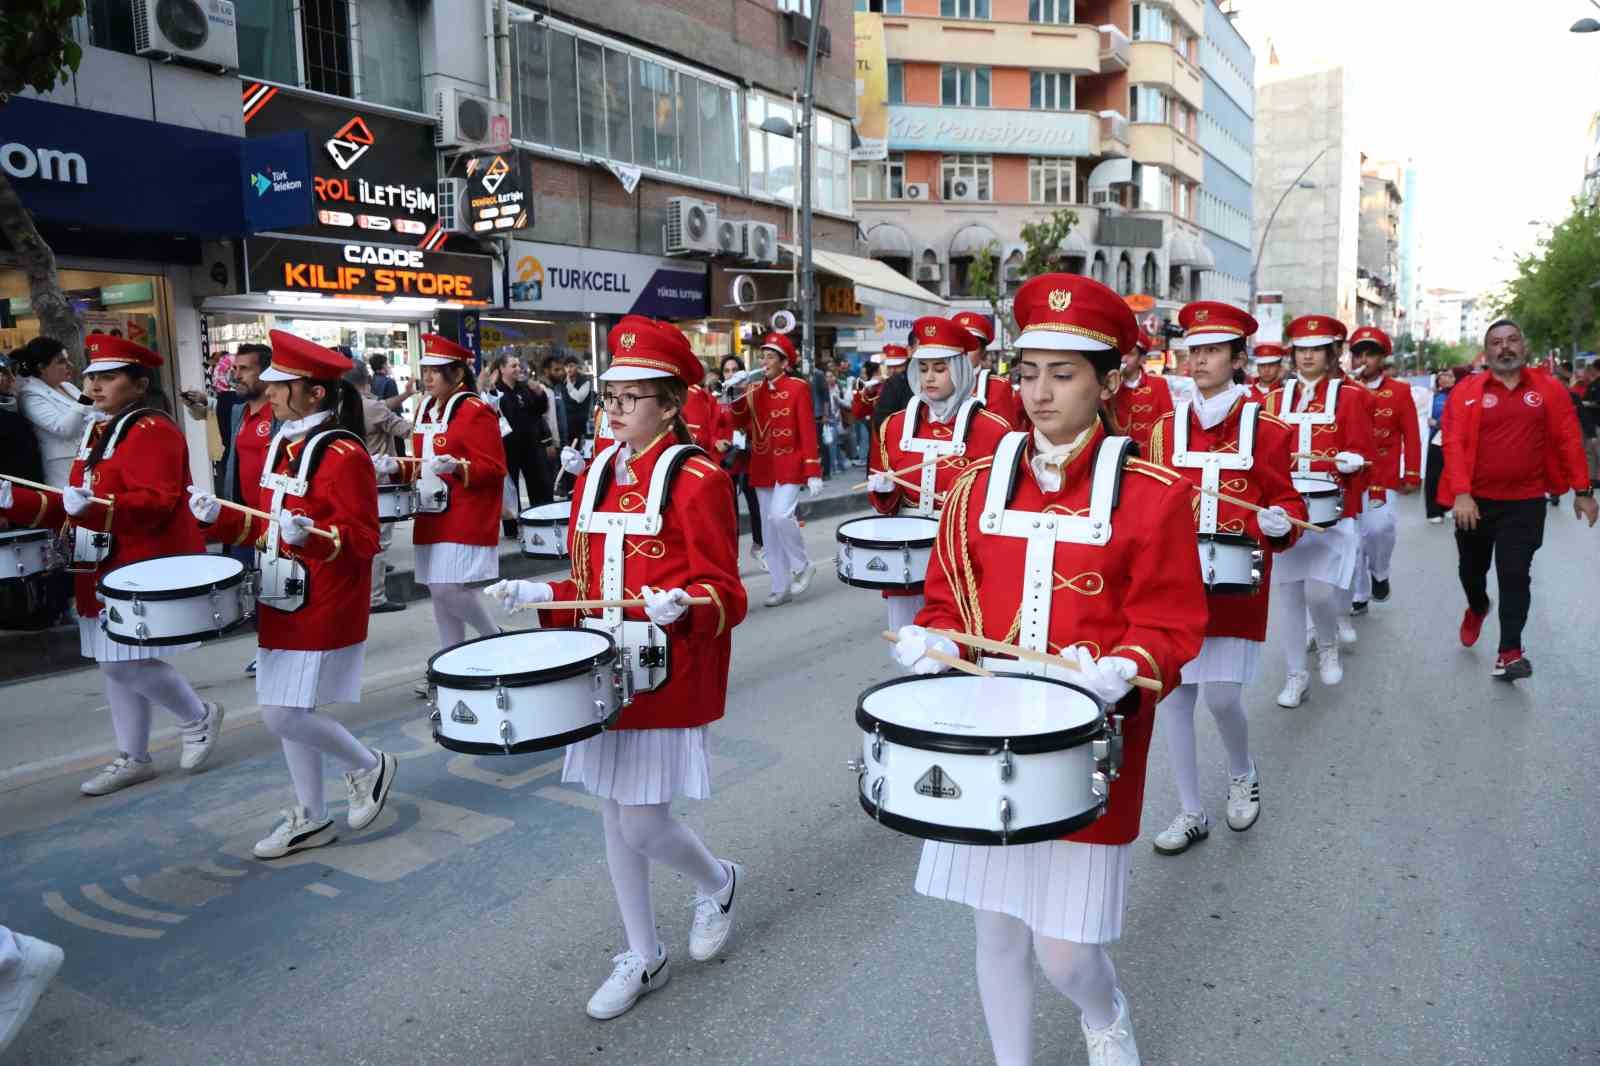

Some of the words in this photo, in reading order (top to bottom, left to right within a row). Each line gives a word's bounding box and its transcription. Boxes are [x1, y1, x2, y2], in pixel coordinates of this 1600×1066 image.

[272, 180, 302, 192] Telekom
[343, 245, 424, 269] CADDE
[284, 262, 366, 291] KILIF
[374, 268, 473, 297] STORE
[547, 266, 631, 293] TURKCELL
